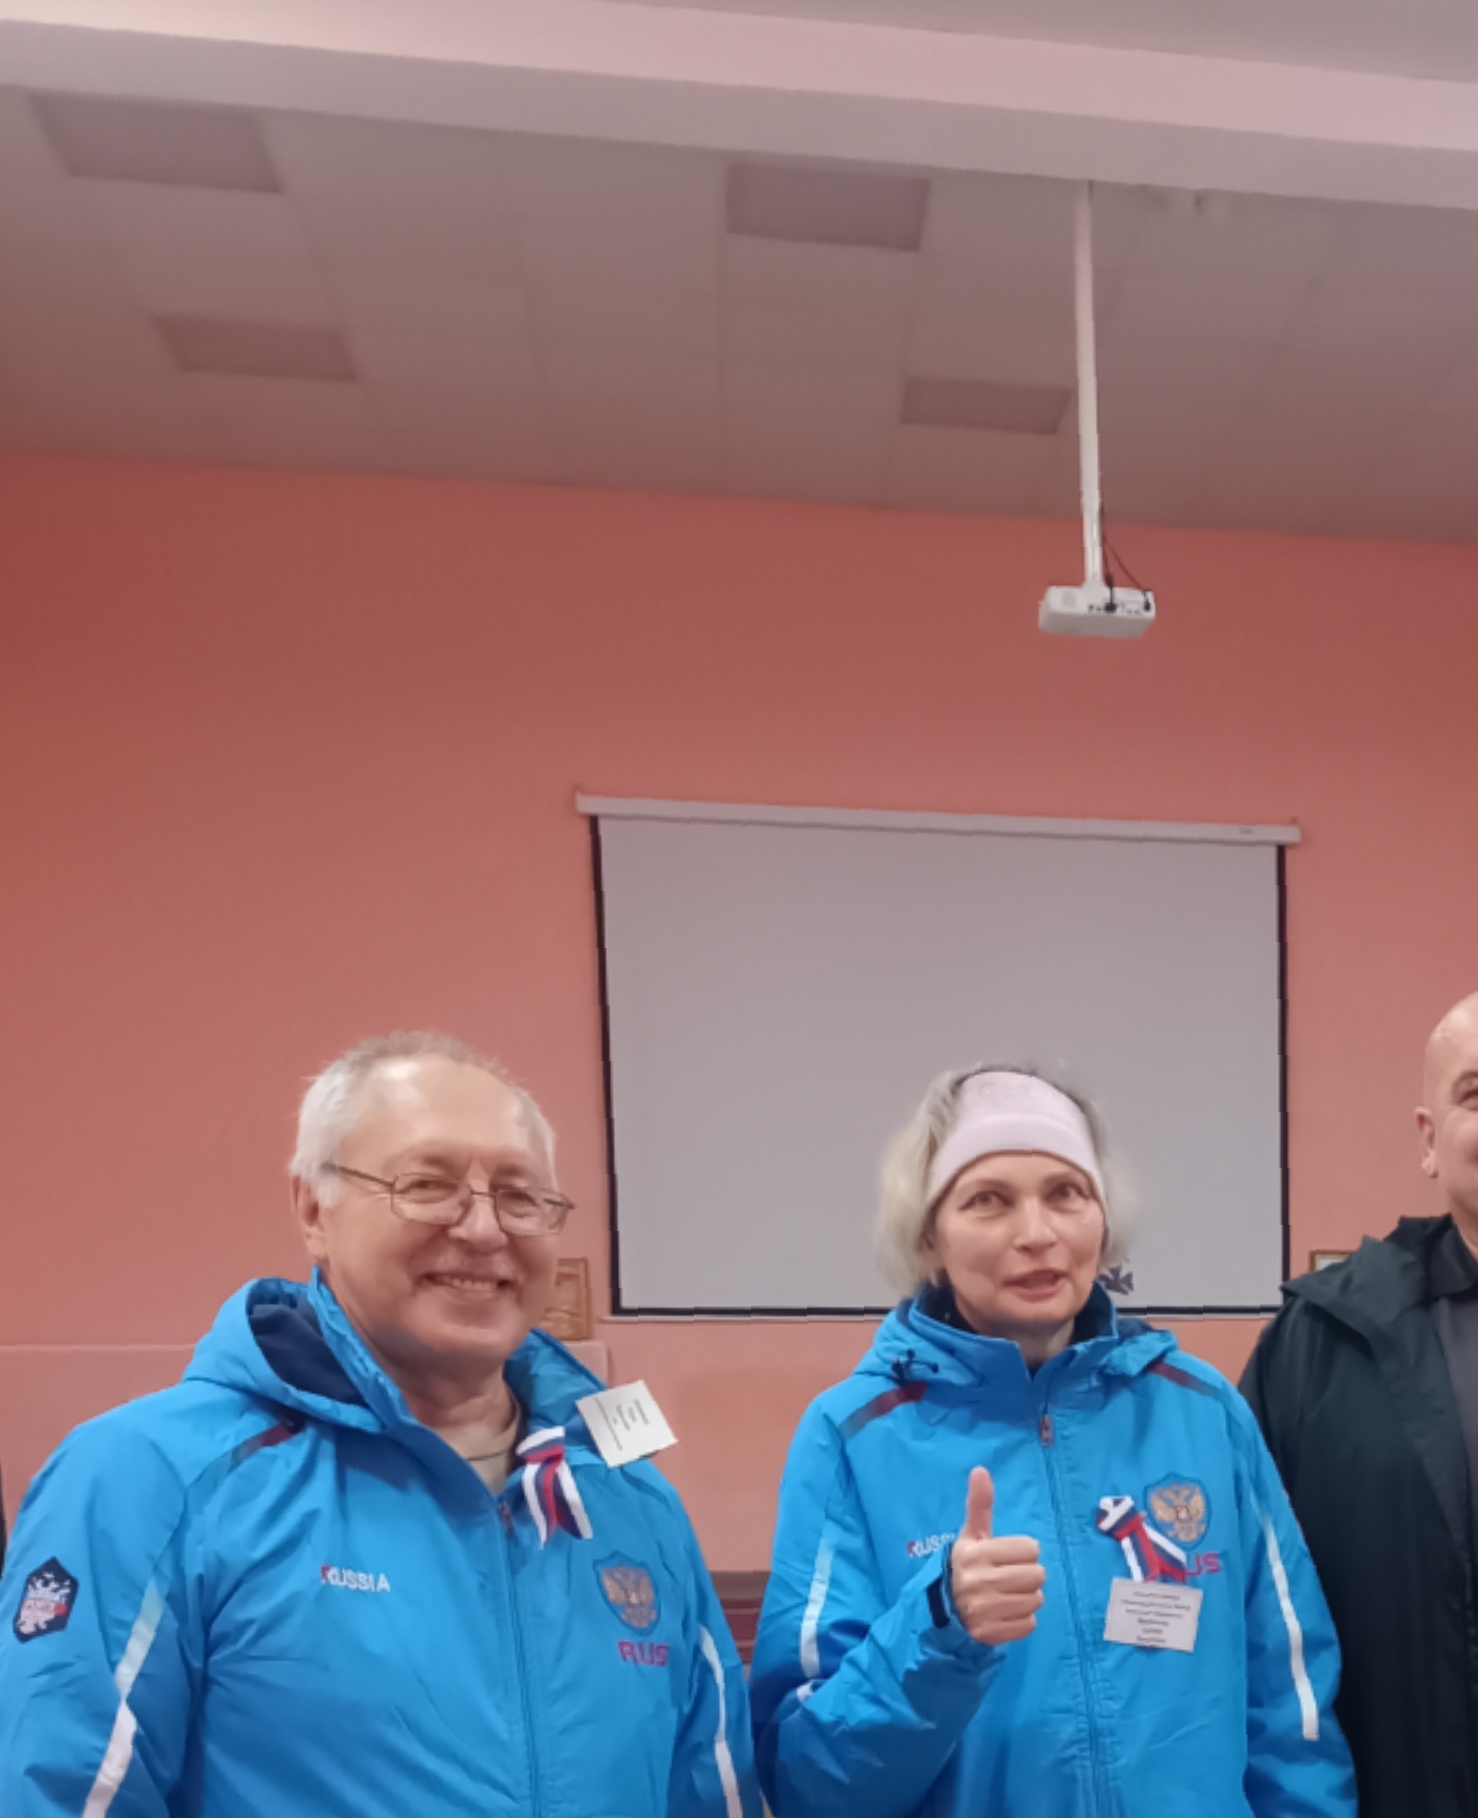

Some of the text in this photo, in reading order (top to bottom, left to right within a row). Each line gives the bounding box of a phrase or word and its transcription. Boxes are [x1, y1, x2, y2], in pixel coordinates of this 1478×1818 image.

[1184, 1552, 1221, 1576] US
[320, 1564, 391, 1592] RUSSIA
[617, 1640, 669, 1667] RUS
